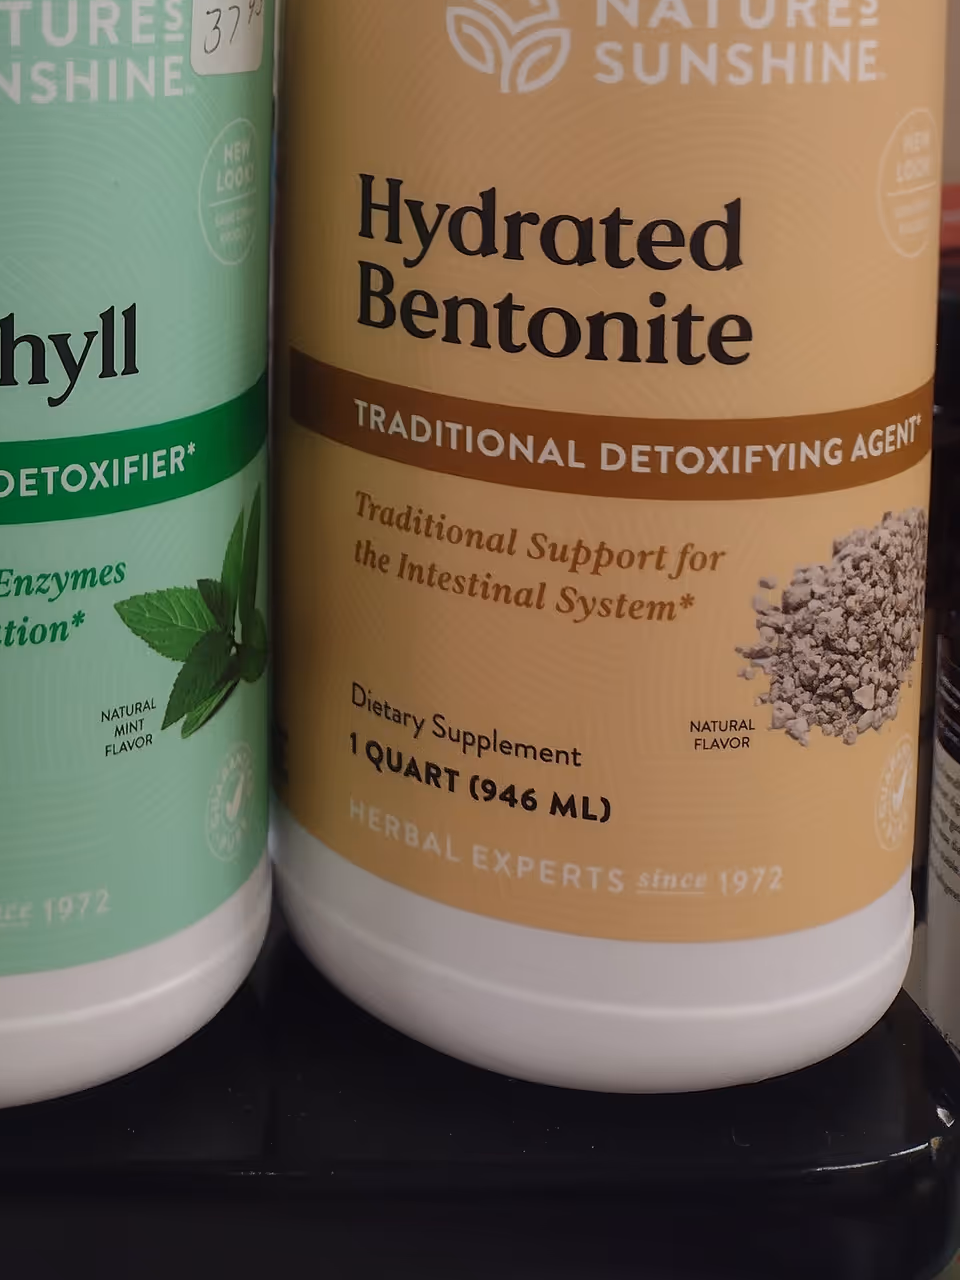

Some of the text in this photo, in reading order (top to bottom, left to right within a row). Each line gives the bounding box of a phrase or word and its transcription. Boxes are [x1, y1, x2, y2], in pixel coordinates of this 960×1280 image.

[595, 40, 878, 87] SUNSHINE
[358, 173, 743, 272] Hydrated
[357, 260, 753, 366] Bentonite
[354, 398, 586, 470] TRADITIONAL
[600, 437, 842, 476] DETOXIFYING
[354, 490, 727, 580] Traditional Support for
[354, 539, 391, 574] the
[396, 545, 546, 610] Intestinal
[101, 698, 156, 722] NATURAL
[105, 734, 152, 756] FLAVOR
[114, 718, 144, 737] MINT
[351, 683, 583, 768] Dietary Supplement
[690, 719, 755, 732] NATURAL
[694, 736, 749, 750] FLAVOR
[349, 733, 612, 823] 1 QUART (946 ML)
[350, 798, 783, 894] HERBAL EXPERTS since 1972
[43, 890, 110, 922] 1972
